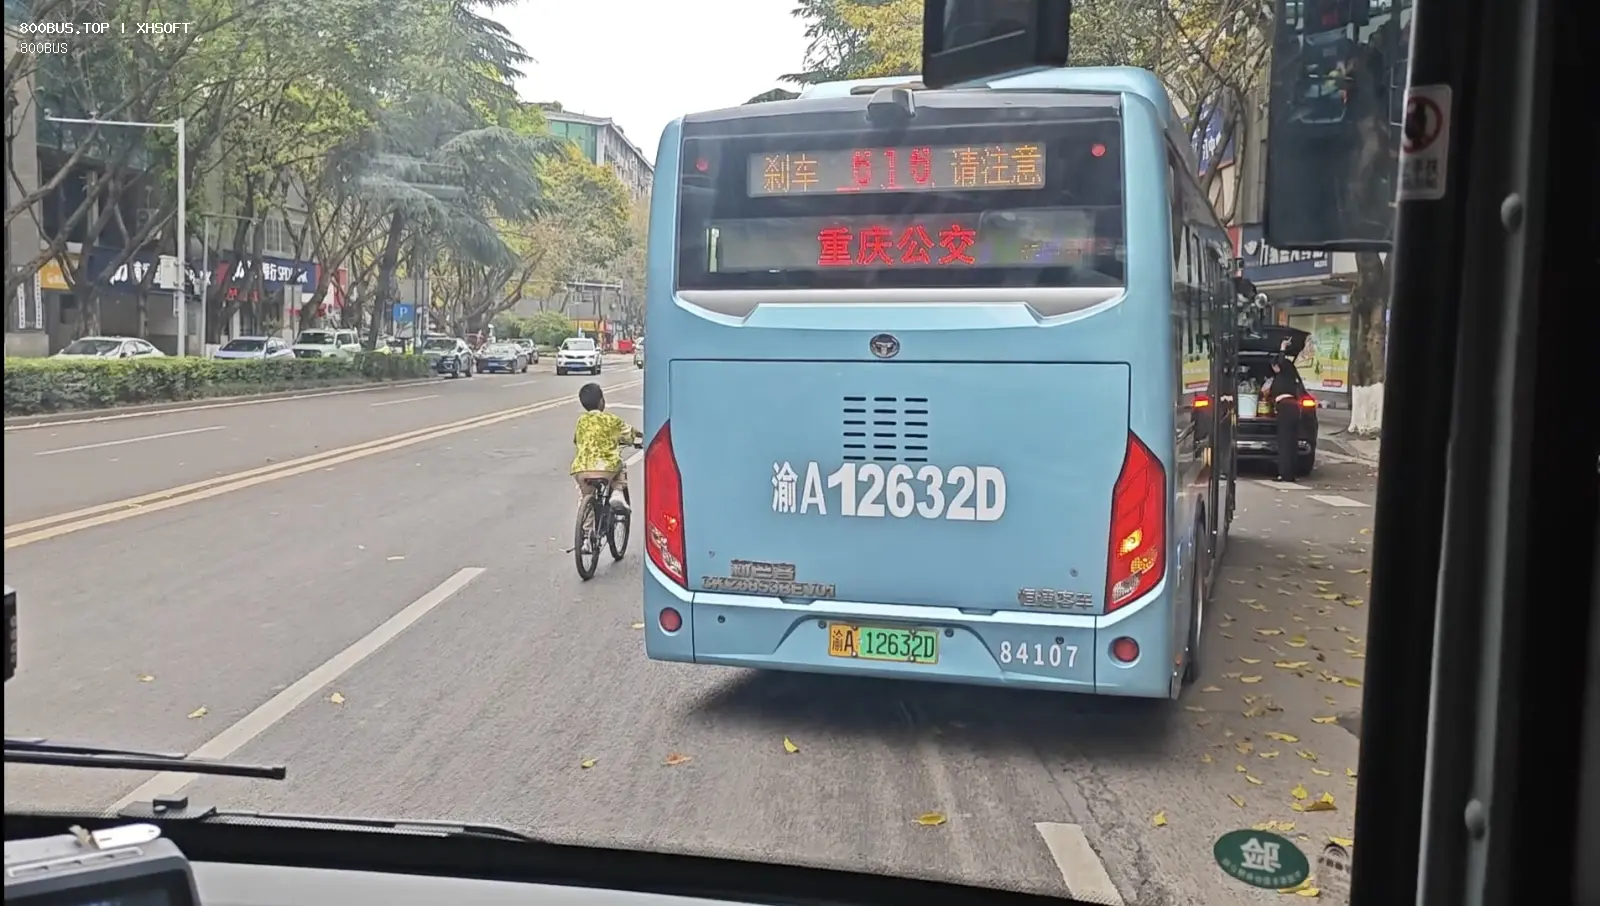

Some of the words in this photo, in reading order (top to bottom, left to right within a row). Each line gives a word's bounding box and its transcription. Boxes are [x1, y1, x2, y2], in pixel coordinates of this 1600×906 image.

[763, 153, 819, 193] 刹车
[950, 144, 1042, 187] 请注意
[817, 224, 977, 267] 重庆公交
[399, 306, 408, 319] P
[771, 461, 1007, 522] 渝A12632D
[1017, 587, 1094, 610] 恒通客车
[1000, 640, 1079, 668] 84107
